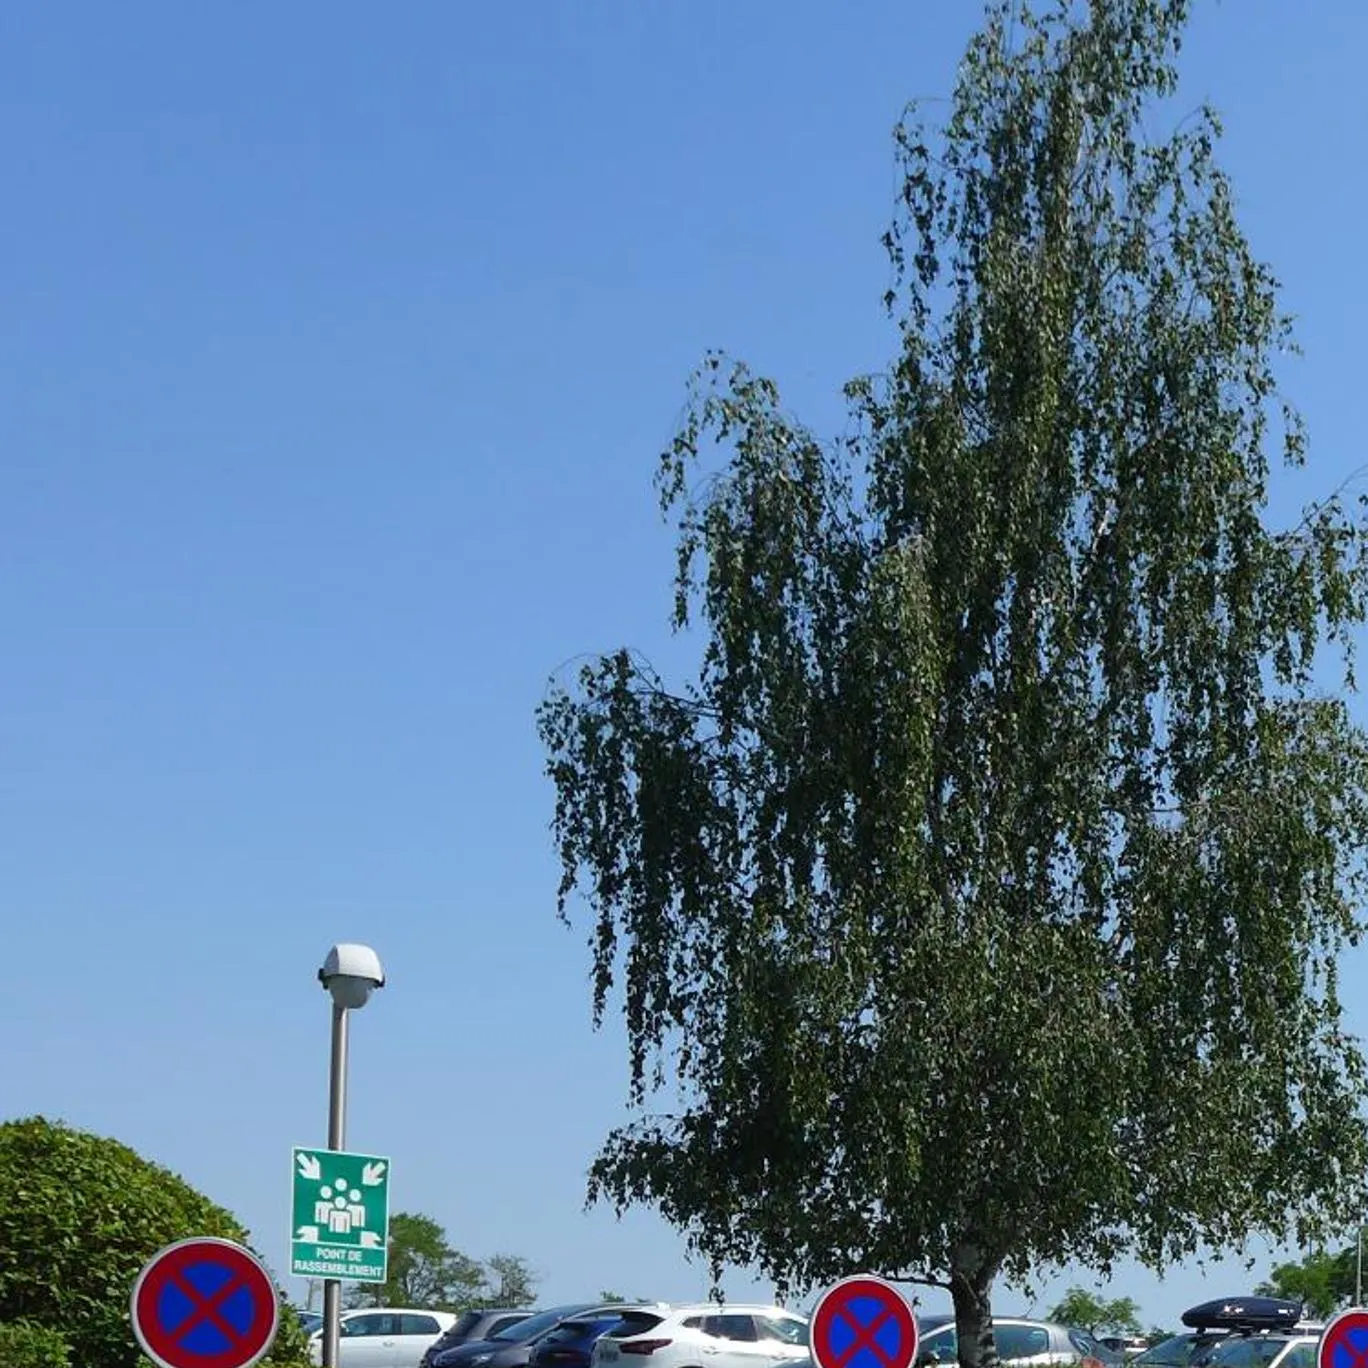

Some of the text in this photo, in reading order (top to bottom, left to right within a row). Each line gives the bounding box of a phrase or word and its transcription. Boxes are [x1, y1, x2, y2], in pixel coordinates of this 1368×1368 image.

[316, 1247, 362, 1262] POINT DE
[294, 1259, 383, 1277] RASSEMBLEMENT
